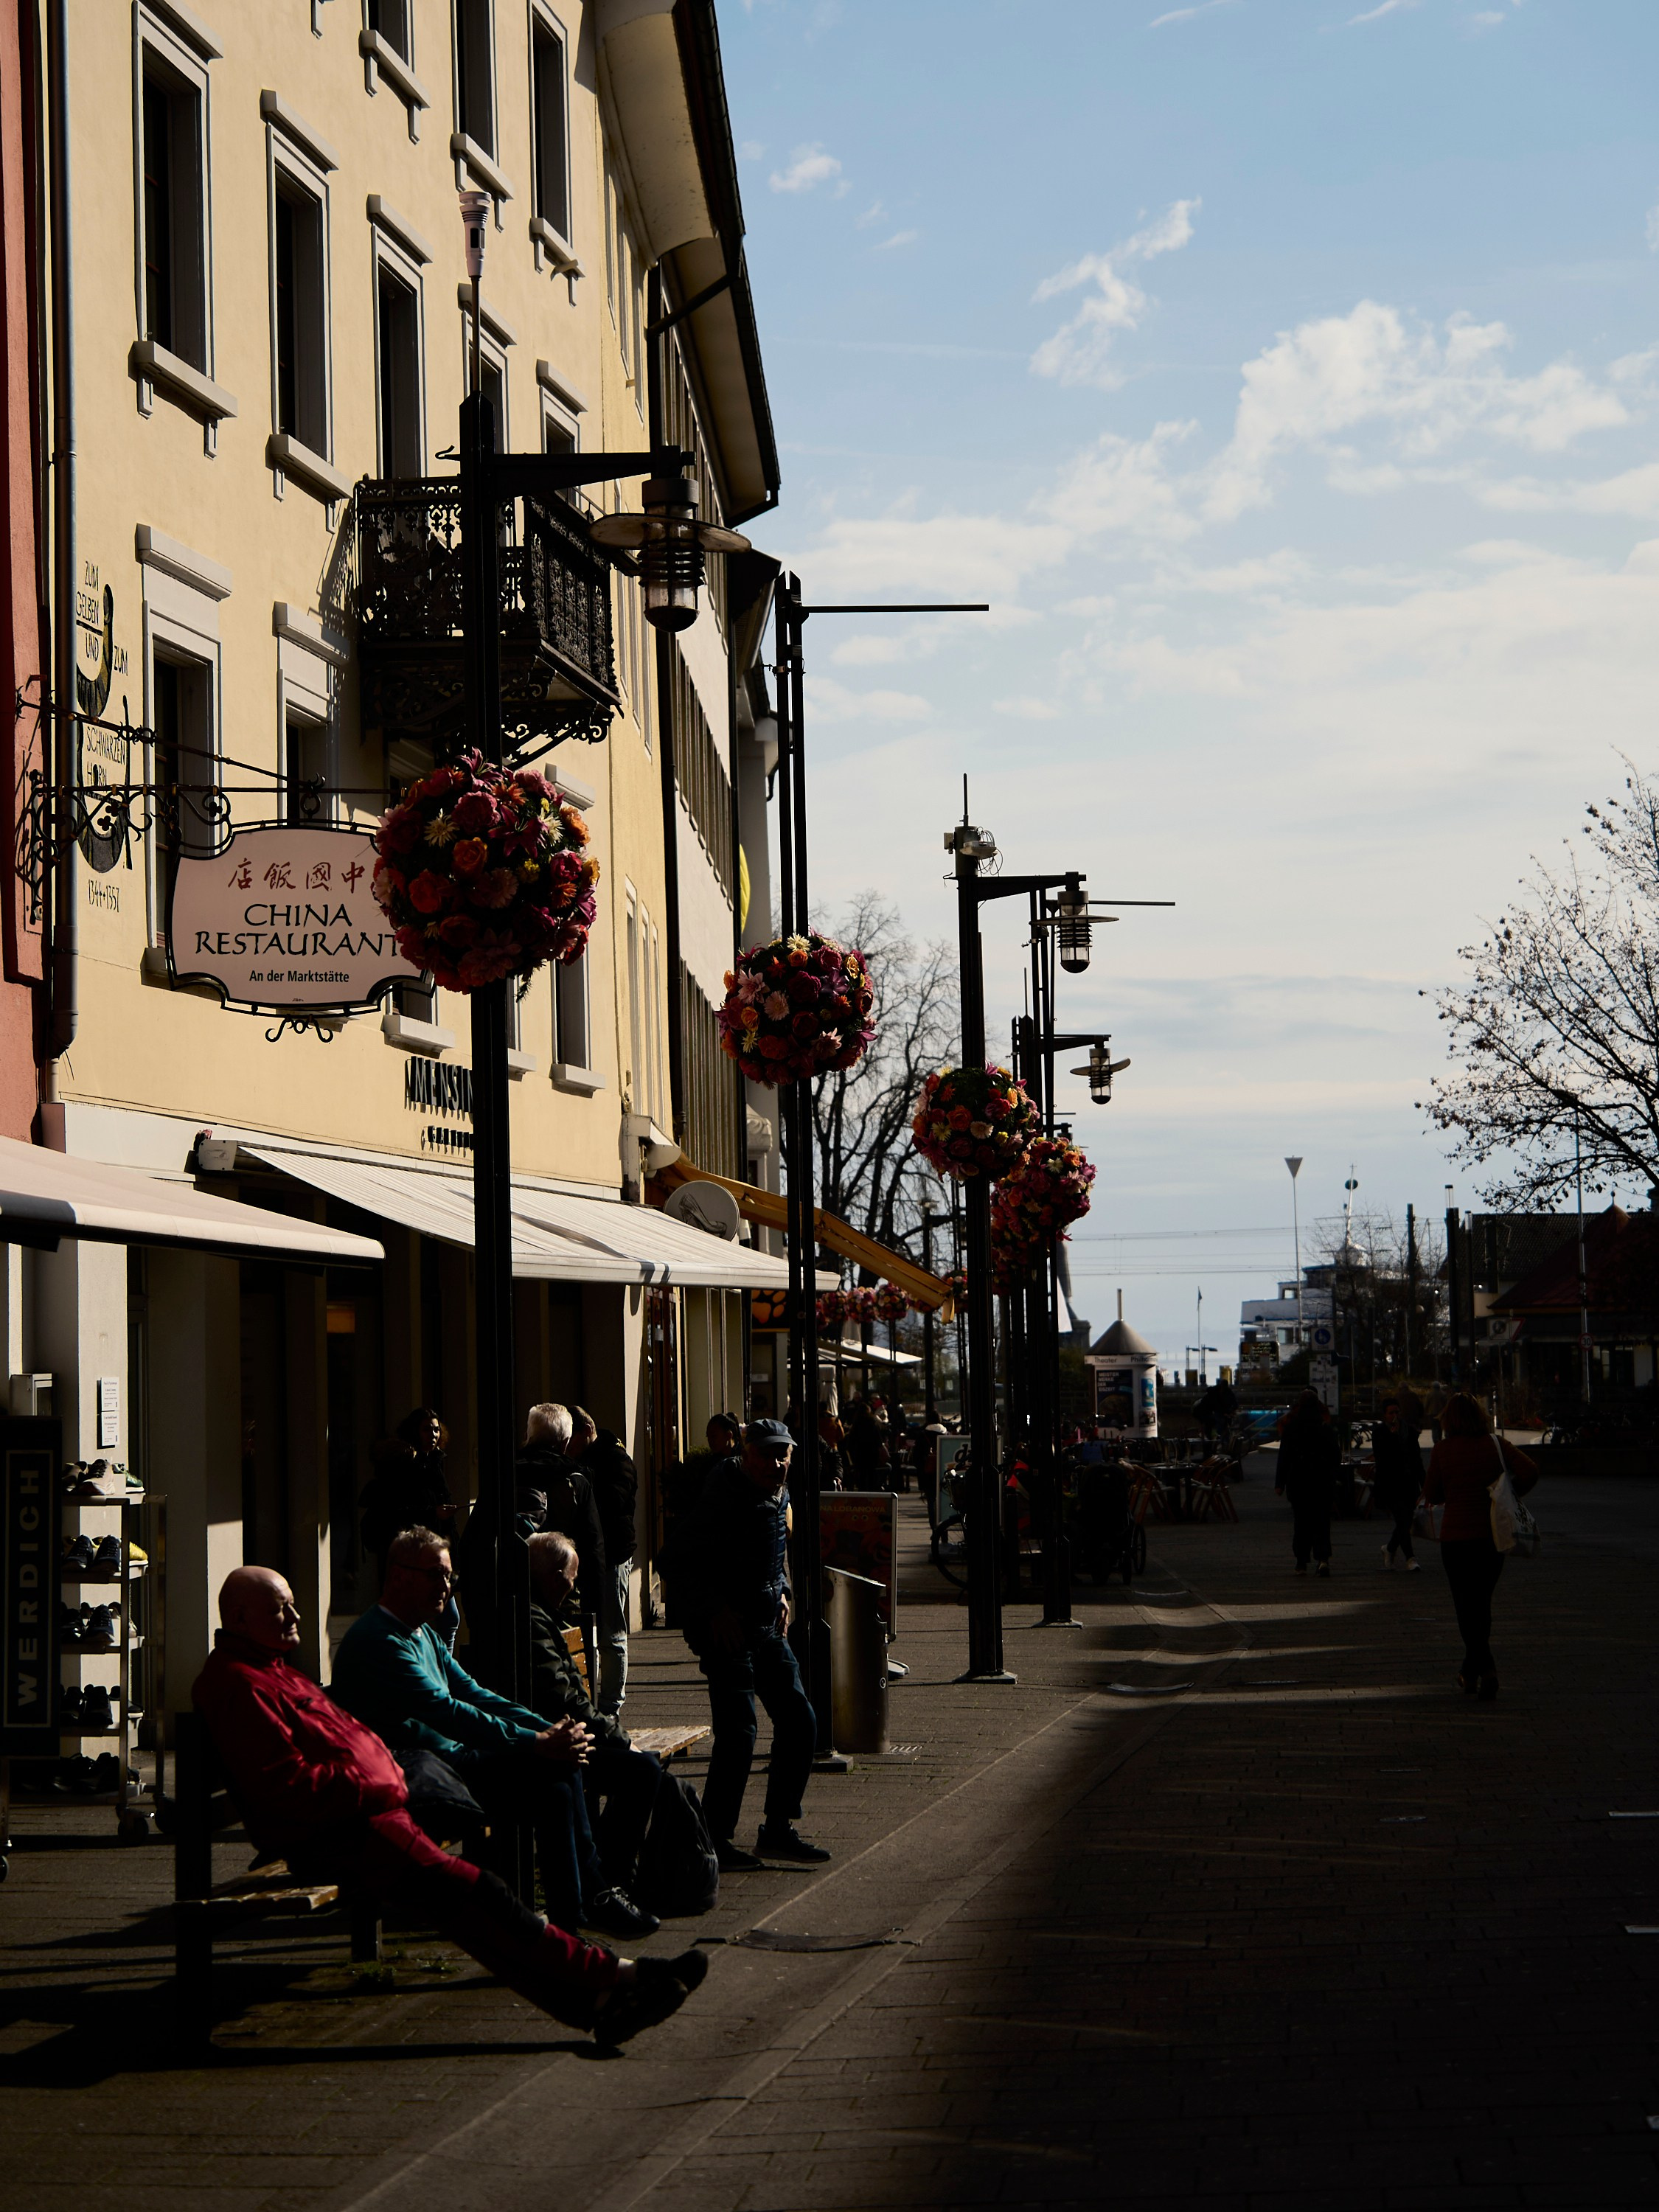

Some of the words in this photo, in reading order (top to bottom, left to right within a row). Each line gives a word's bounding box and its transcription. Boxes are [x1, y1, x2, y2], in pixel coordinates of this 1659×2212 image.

[85, 560, 99, 591] ZUM
[76, 591, 99, 625] GELBEN
[85, 633, 99, 662] UND
[114, 645, 128, 676] ZUM
[86, 726, 125, 765] SCHWARZEN
[244, 903, 352, 928] CHINA
[249, 970, 264, 982] An
[267, 970, 285, 982] der
[288, 970, 349, 983] Marktstätte
[1582, 1338, 1591, 1346] 30
[17, 1469, 41, 1708] WERDICH
